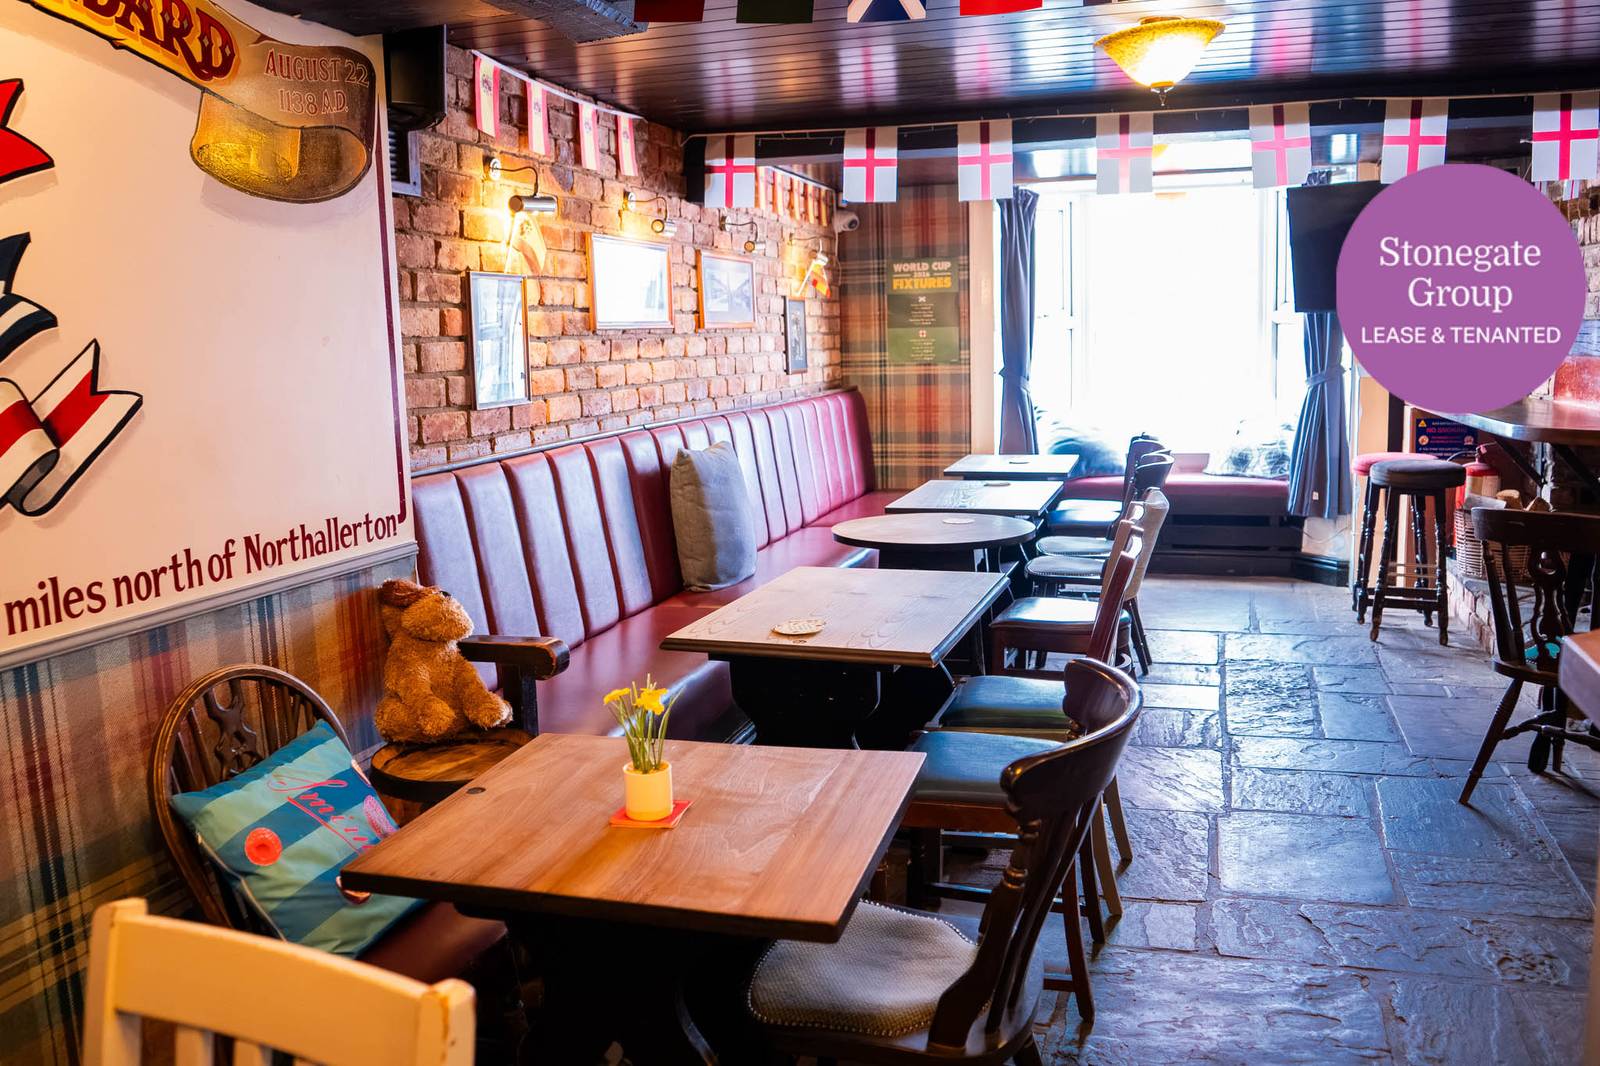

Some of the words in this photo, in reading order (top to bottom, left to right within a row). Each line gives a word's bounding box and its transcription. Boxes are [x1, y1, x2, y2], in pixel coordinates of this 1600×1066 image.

[264, 48, 341, 82] AUGUST
[345, 59, 370, 87] 22
[279, 88, 318, 116] 1138
[322, 89, 349, 114] A.D.
[893, 262, 929, 272] WORLD
[931, 261, 951, 271] CUP
[892, 276, 952, 290] FIXTURES
[4, 576, 106, 635] miles
[113, 548, 204, 608] north
[207, 539, 236, 582] of
